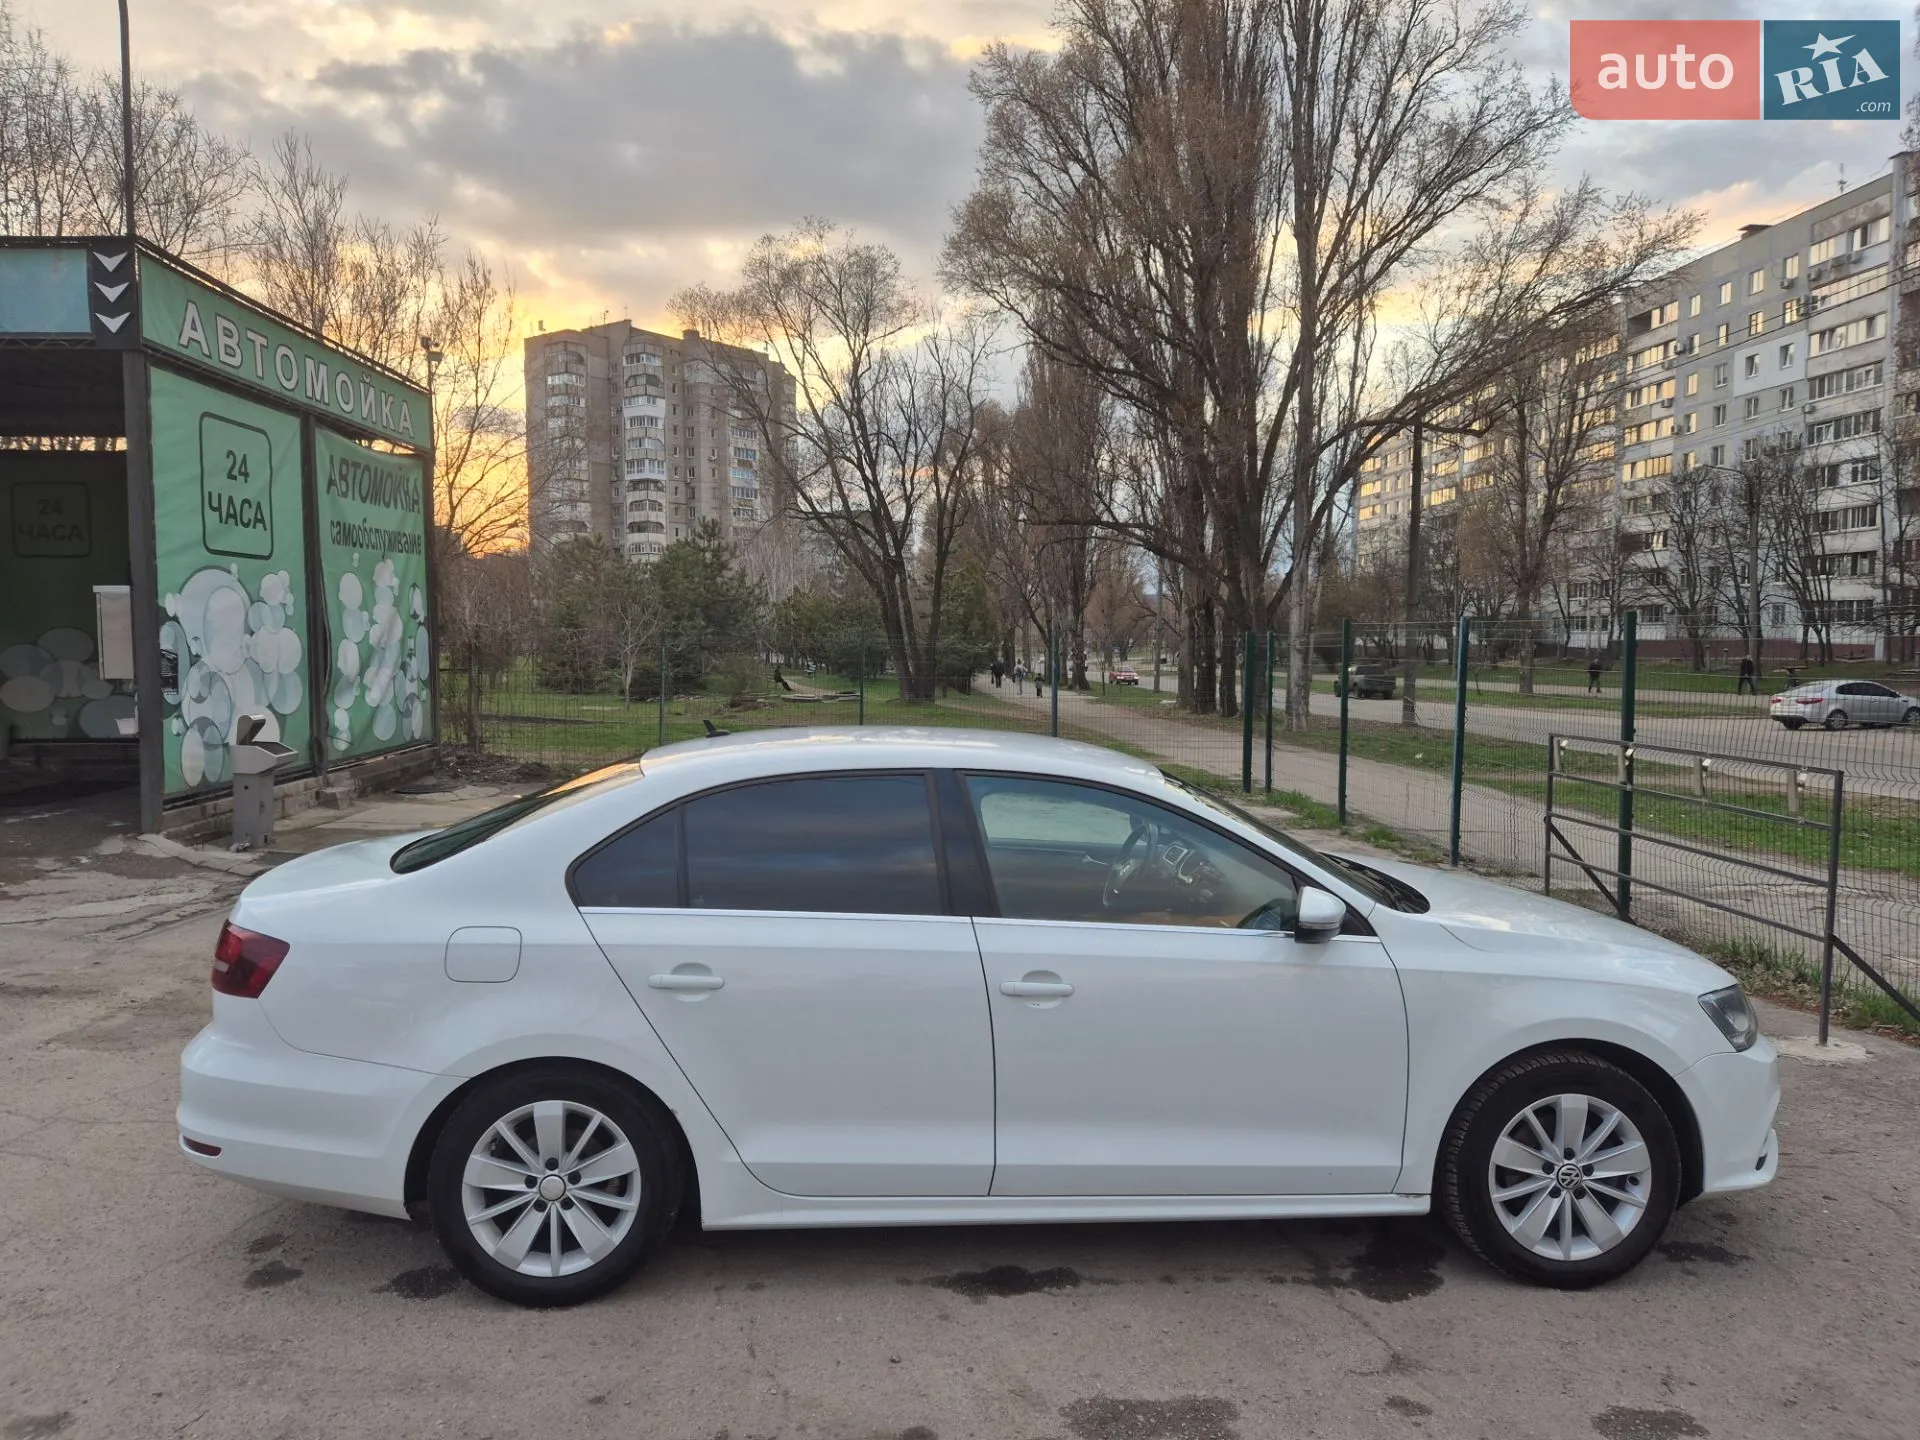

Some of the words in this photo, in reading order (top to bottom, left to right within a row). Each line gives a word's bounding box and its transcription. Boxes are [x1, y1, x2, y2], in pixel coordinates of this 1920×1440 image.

[178, 298, 416, 439] АВТОМОЙКА
[226, 449, 250, 484] 24
[38, 498, 63, 516] 24
[207, 490, 268, 531] ЧАСА
[18, 523, 84, 542] ЧАСА
